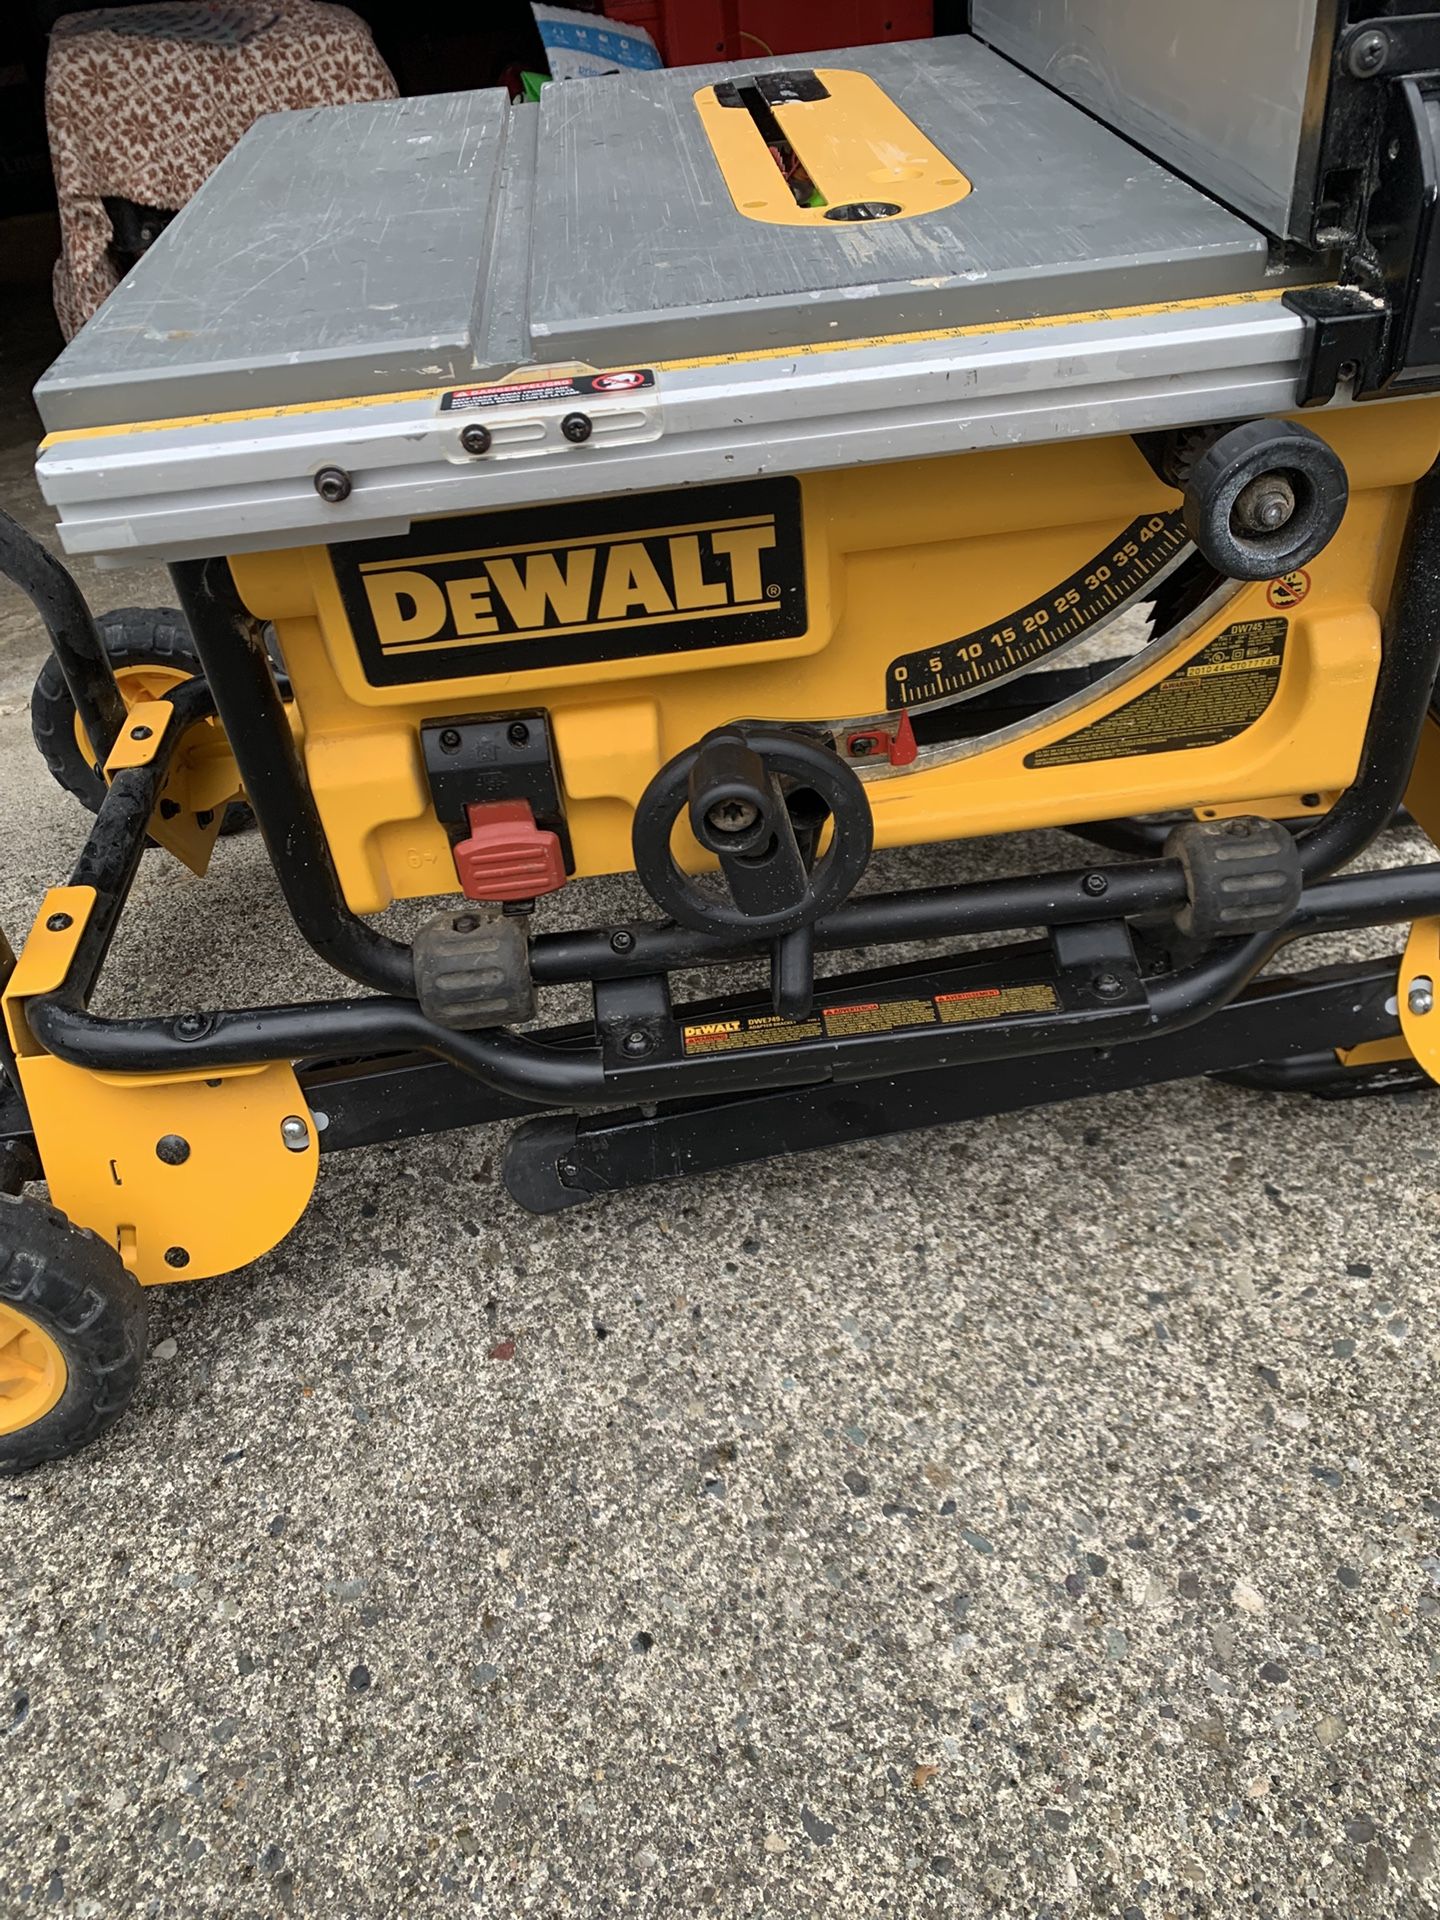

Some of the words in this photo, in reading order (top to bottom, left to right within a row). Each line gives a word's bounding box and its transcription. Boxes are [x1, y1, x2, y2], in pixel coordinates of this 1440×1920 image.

[894, 666, 908, 682] 0
[929, 657, 943, 673] 5
[956, 643, 983, 662] 10
[991, 628, 1017, 648] 15
[1022, 609, 1050, 633] 20
[1054, 588, 1081, 614] 25
[1084, 566, 1112, 591] 30
[1112, 541, 1140, 567] 35
[1139, 517, 1165, 543] 40
[1231, 621, 1263, 635] DW745
[944, 989, 999, 1001] AVERTISSEMENT
[833, 1004, 878, 1014] ADVERTENCIA
